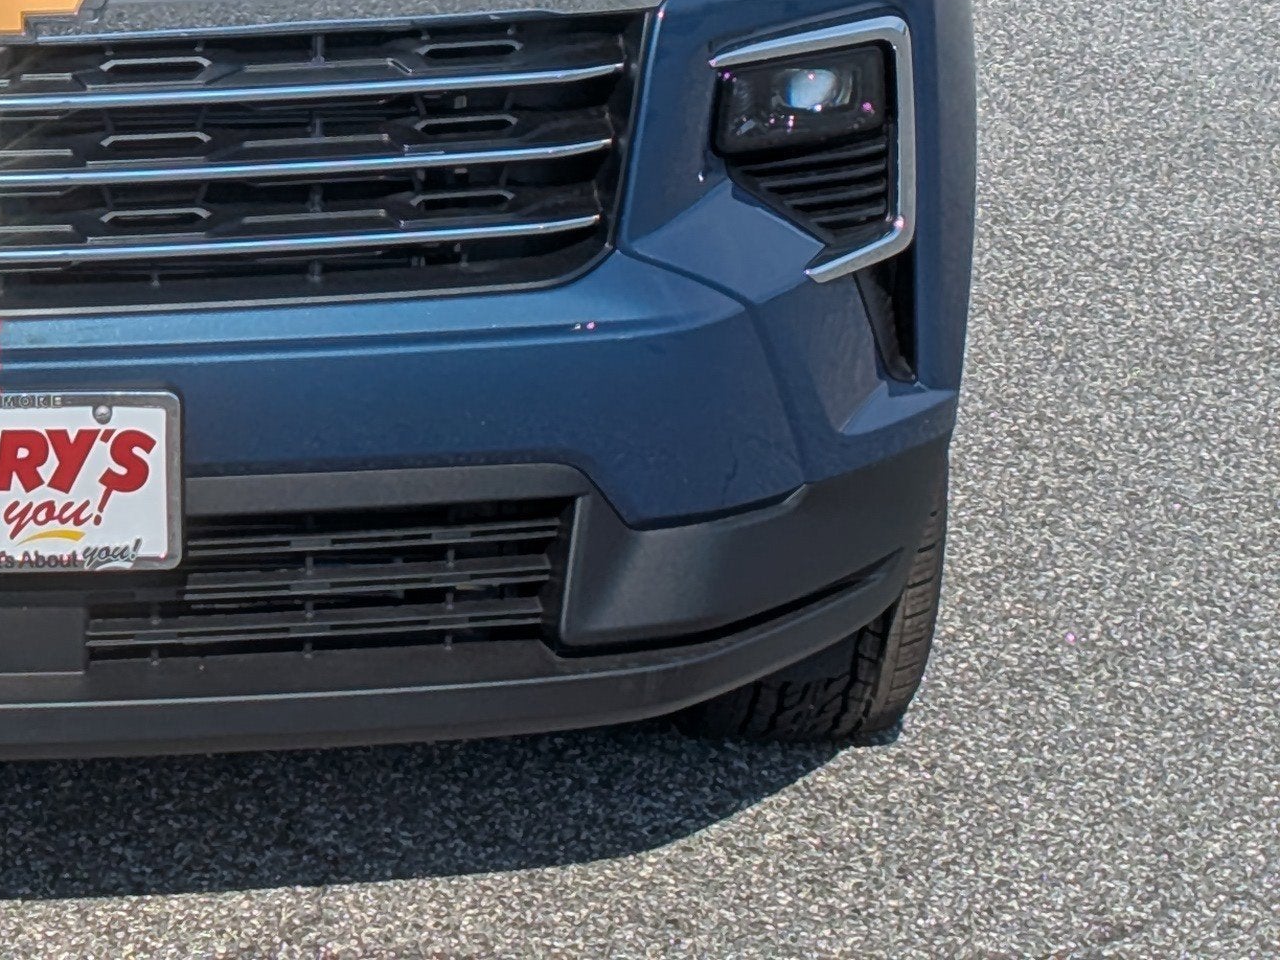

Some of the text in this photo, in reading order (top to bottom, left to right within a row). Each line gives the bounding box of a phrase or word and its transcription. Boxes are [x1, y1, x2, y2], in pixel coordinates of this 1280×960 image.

[3, 486, 114, 540] you!
[19, 549, 79, 569] About
[82, 538, 143, 570] you!
